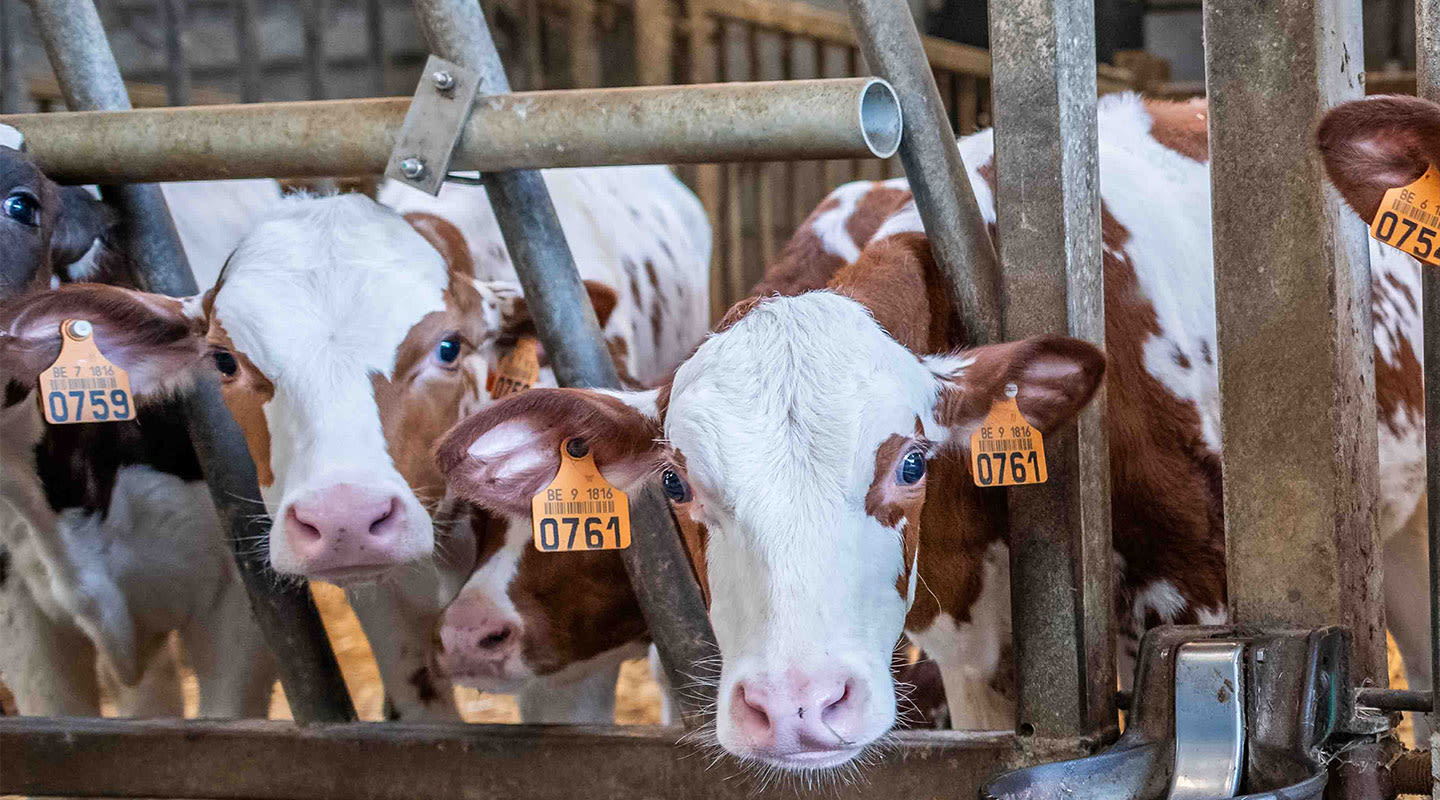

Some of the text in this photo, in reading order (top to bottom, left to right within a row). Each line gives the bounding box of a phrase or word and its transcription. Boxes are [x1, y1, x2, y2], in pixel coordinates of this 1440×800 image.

[1399, 188, 1416, 204] BE
[1420, 199, 1428, 210] 6
[52, 365, 114, 378] BE 7 1816
[48, 389, 130, 422] 0759
[981, 426, 1031, 439] BE 9 1816
[977, 451, 1040, 485] 0761
[547, 488, 613, 501] BE 9 1816
[540, 516, 621, 551] 0761
